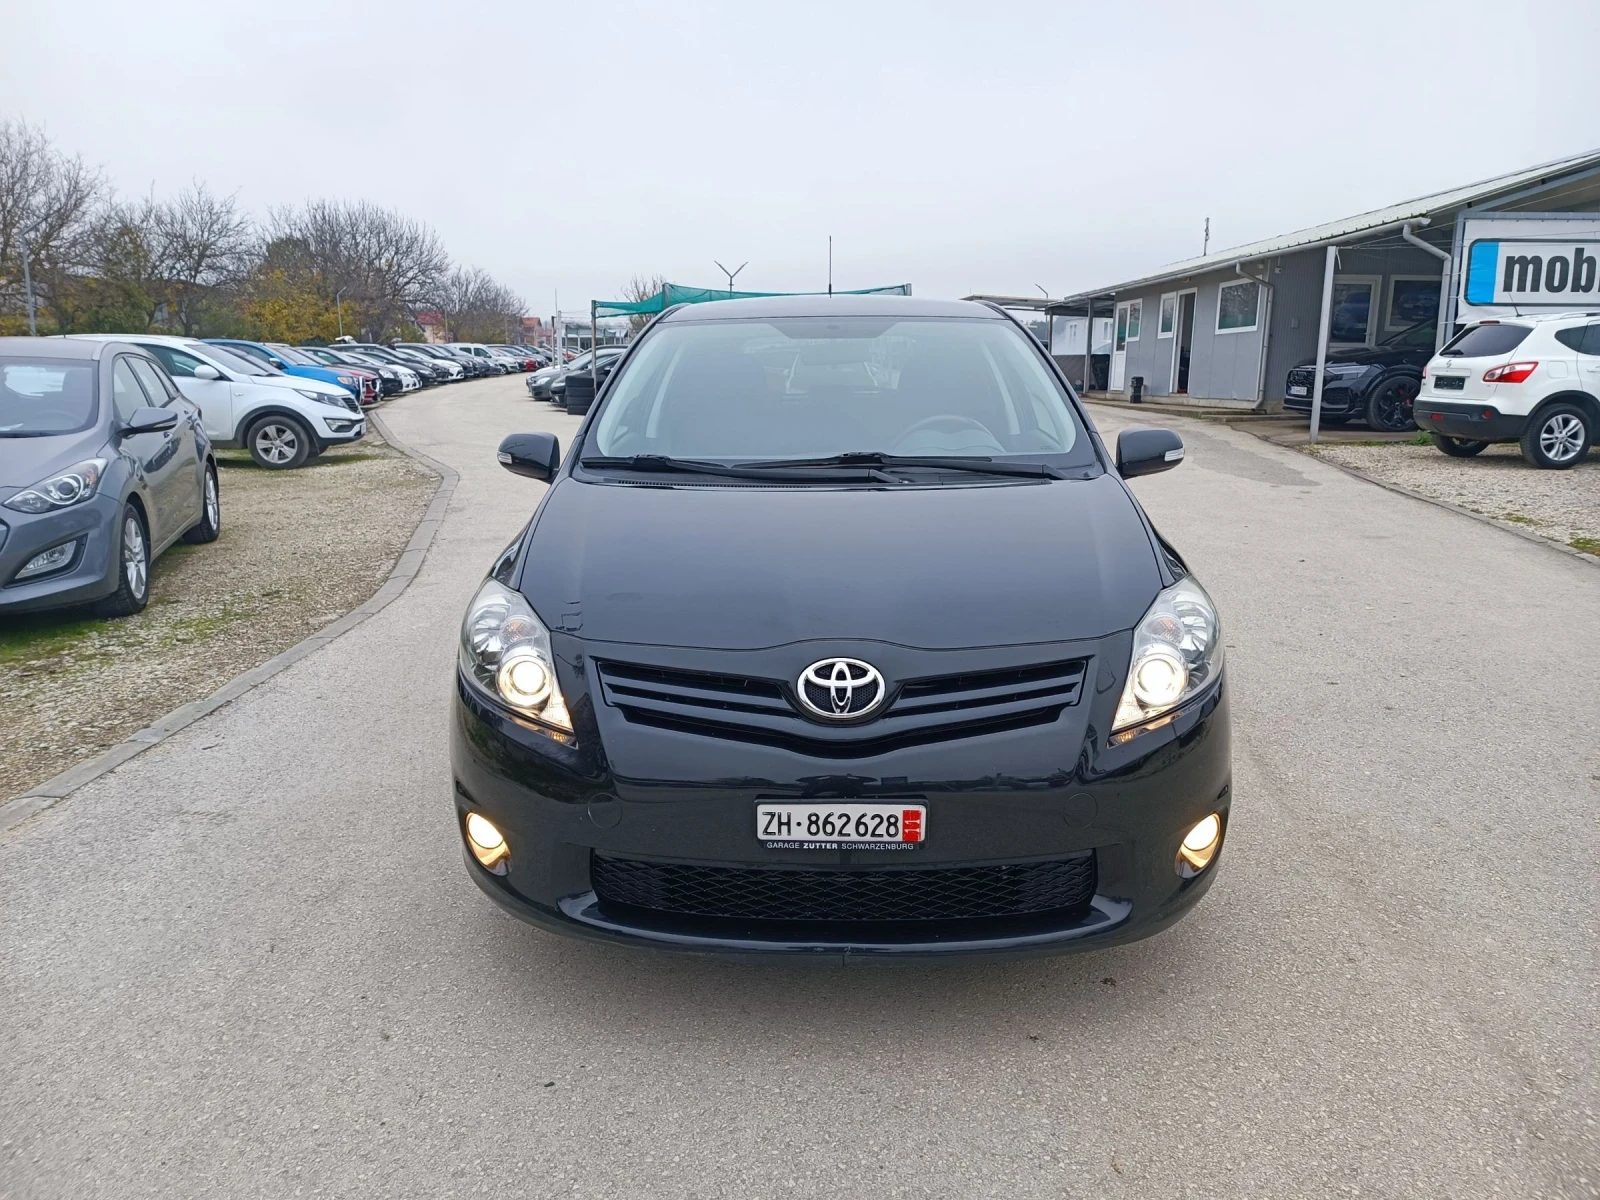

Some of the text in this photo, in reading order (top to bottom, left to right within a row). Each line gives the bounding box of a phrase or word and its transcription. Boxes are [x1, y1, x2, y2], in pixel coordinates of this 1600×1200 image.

[1503, 247, 1600, 293] mob
[766, 841, 800, 849] GARAGE
[803, 842, 838, 850] ZUTTER
